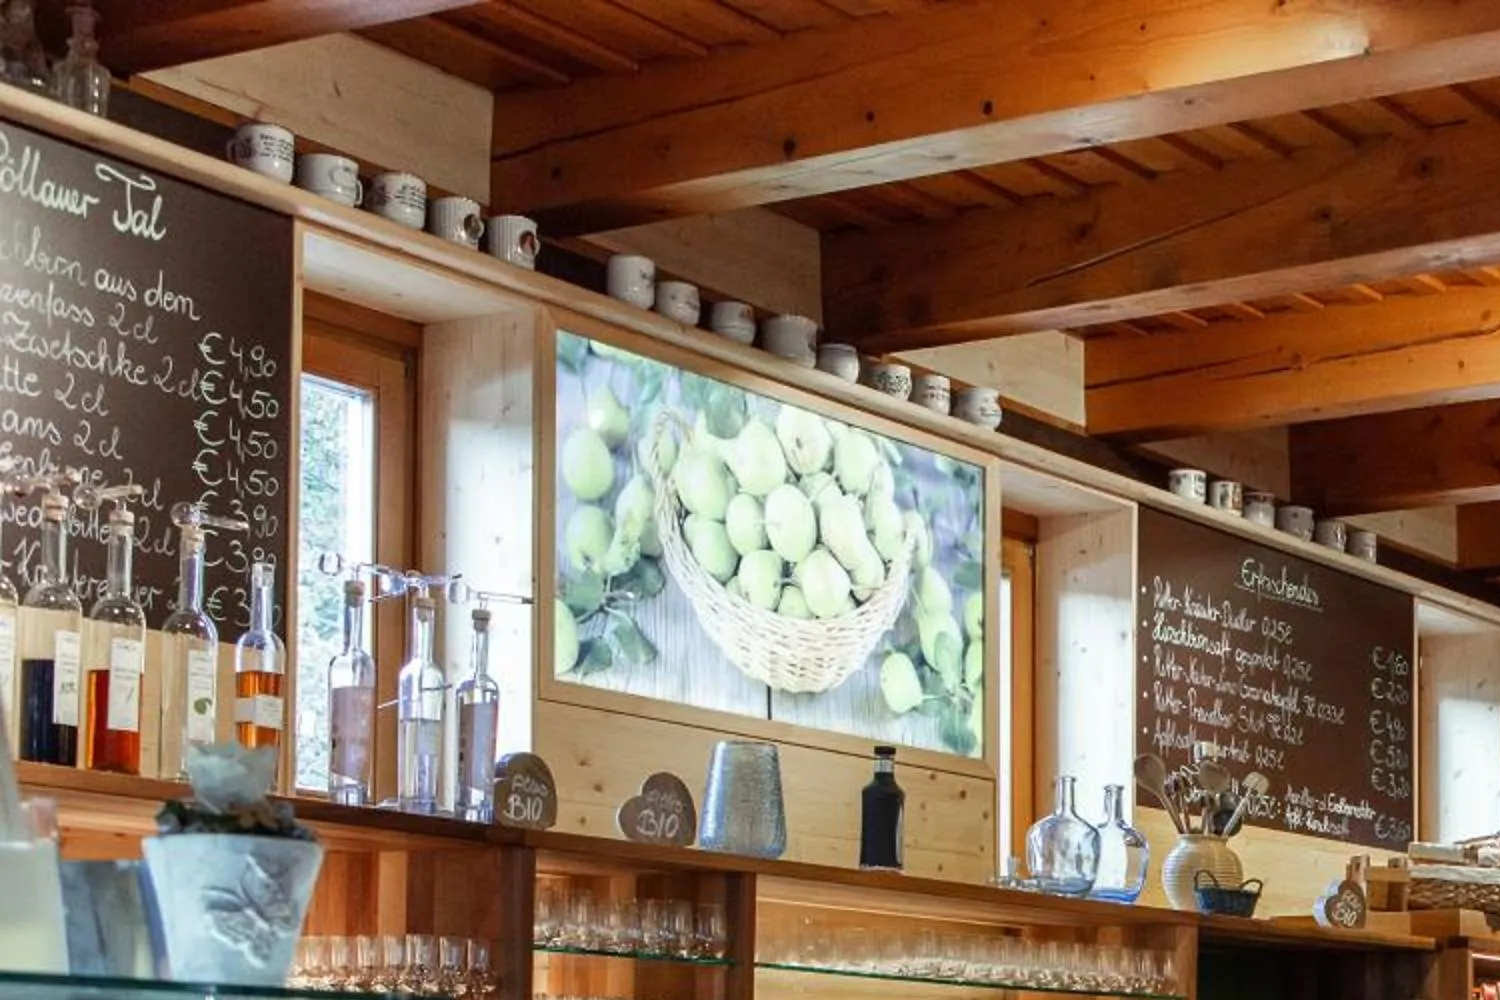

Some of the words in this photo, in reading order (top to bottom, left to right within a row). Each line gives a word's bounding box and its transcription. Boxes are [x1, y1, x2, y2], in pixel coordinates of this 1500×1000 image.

[95, 163, 167, 240] Tal
[94, 267, 138, 301] aus
[145, 270, 200, 321] dem
[4, 311, 148, 386] Zwetschke
[504, 794, 543, 822] BIO
[637, 809, 679, 839] BIO
